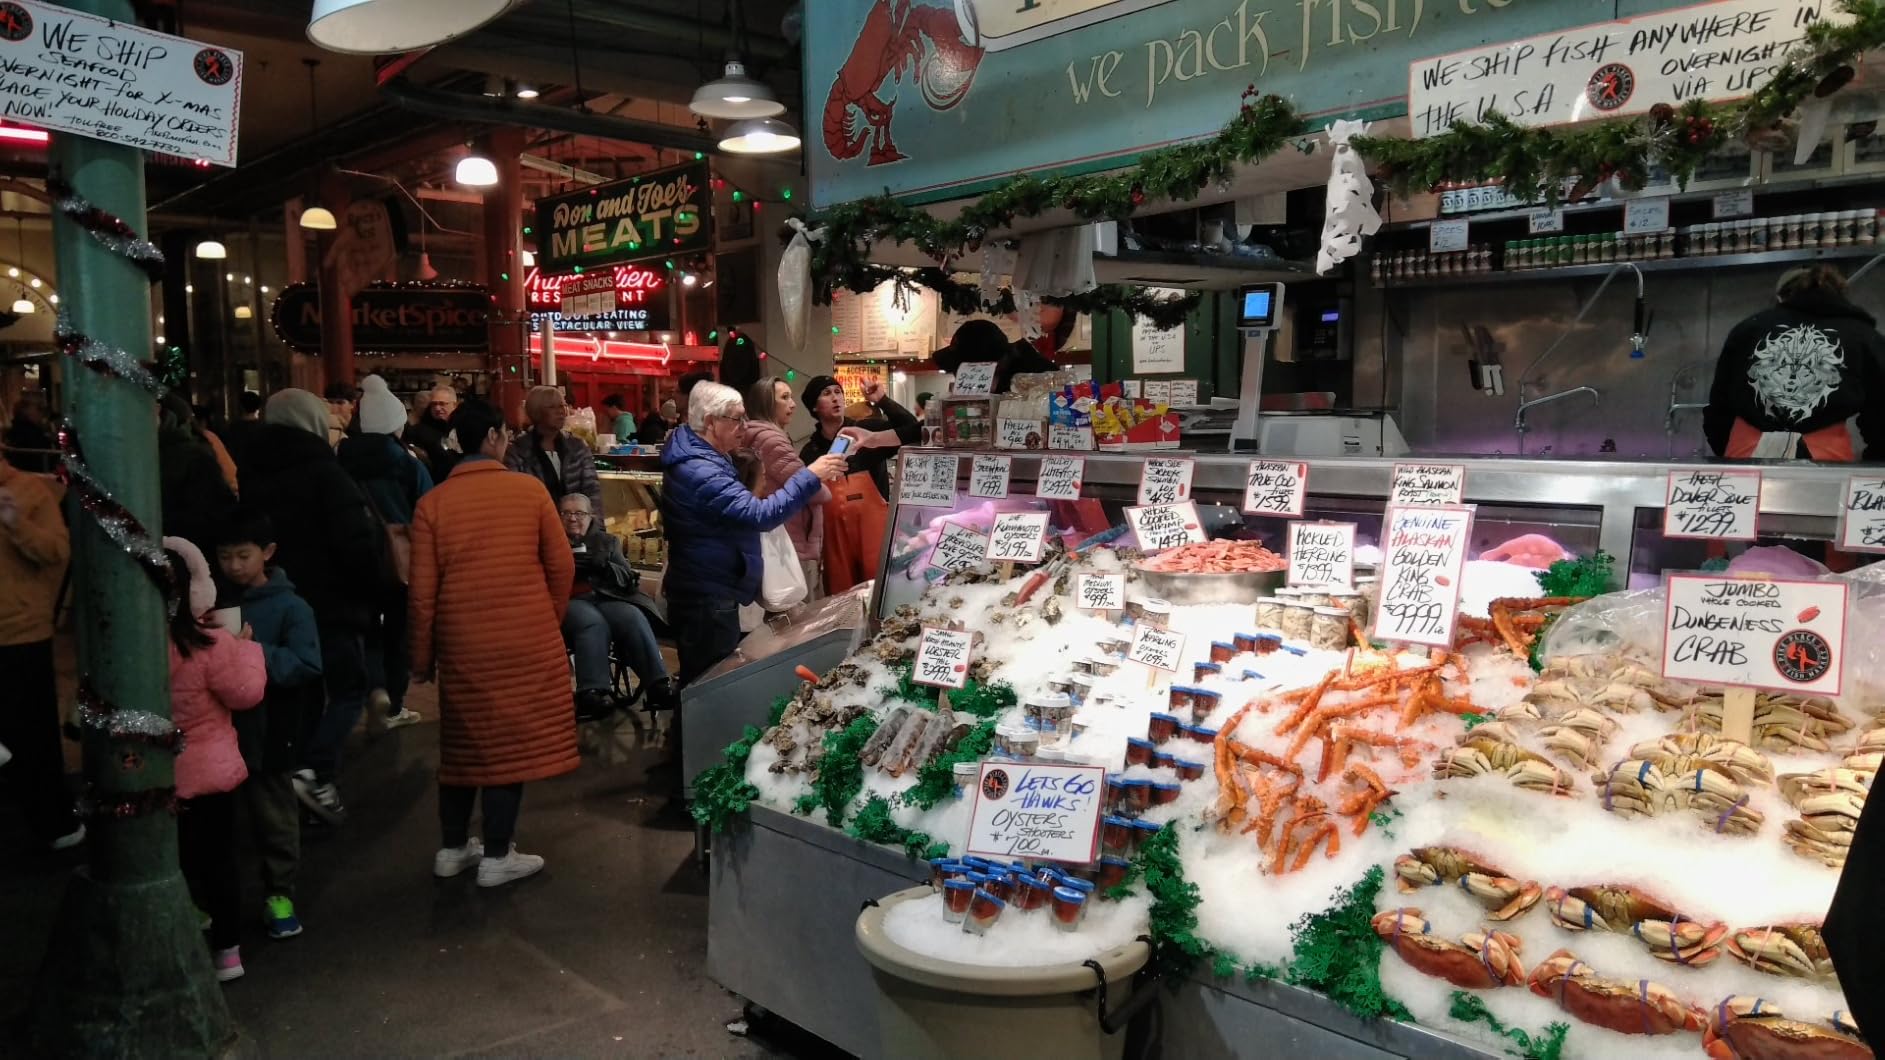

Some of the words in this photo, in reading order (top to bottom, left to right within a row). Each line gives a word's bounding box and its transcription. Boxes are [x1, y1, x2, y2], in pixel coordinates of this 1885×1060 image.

[43, 19, 89, 51] WE
[97, 36, 168, 70] SHIP
[1424, 59, 1460, 90] WE
[1463, 45, 1534, 80] SHIP
[1629, 8, 1778, 55] ANYWHERE
[1794, 0, 1822, 28] IN
[1144, 0, 1272, 109] pack
[1661, 36, 1809, 76] OVERNIGHT
[0, 56, 112, 91] VERNIGHT
[38, 51, 137, 82] SEAFOOD
[1673, 75, 1714, 100] VIA
[4, 100, 52, 118] NOW!
[55, 90, 104, 108] YOUR
[101, 100, 170, 130] HOLIDAY
[167, 116, 228, 139] ORDERS
[1416, 101, 1469, 134] THE
[553, 202, 592, 229] Don
[596, 188, 634, 219] and
[636, 173, 692, 215] Joe's
[552, 203, 700, 259] MEATS
[583, 275, 613, 291] SNACKS
[617, 320, 645, 330] VIEW
[1003, 418, 1037, 431] PAELLA
[1041, 465, 1081, 479] LUTEFISK
[1248, 472, 1276, 486] TRUE
[1275, 473, 1296, 487] COD
[1416, 466, 1453, 475] ALASKAN
[1393, 475, 1416, 488] KING
[1418, 474, 1461, 490] SALMON
[1398, 488, 1428, 497] ROAST
[1669, 487, 1718, 505] DOVER
[1140, 511, 1180, 526] COOKED
[1393, 513, 1461, 531] GENUINE
[1296, 527, 1345, 547] PICKLED
[1391, 530, 1457, 549] ALASKAN
[1293, 547, 1348, 562] HERRING
[1391, 548, 1455, 568] GOLDEN
[1395, 566, 1429, 585] KING
[1386, 583, 1434, 602] CRAB
[1704, 581, 1780, 598] JUMBO
[1701, 597, 1730, 606] WHOLE
[1736, 599, 1782, 608] COOKED
[1671, 606, 1785, 633] DUNGENESS
[925, 645, 961, 659] LOBSTER
[1673, 634, 1748, 665] CRAB
[1015, 769, 1063, 792] LETS
[1063, 774, 1095, 795] GO
[1010, 791, 1091, 812] HAWKS!
[992, 809, 1068, 832] OYSTERS
[1017, 827, 1075, 840] SHOOTERS
